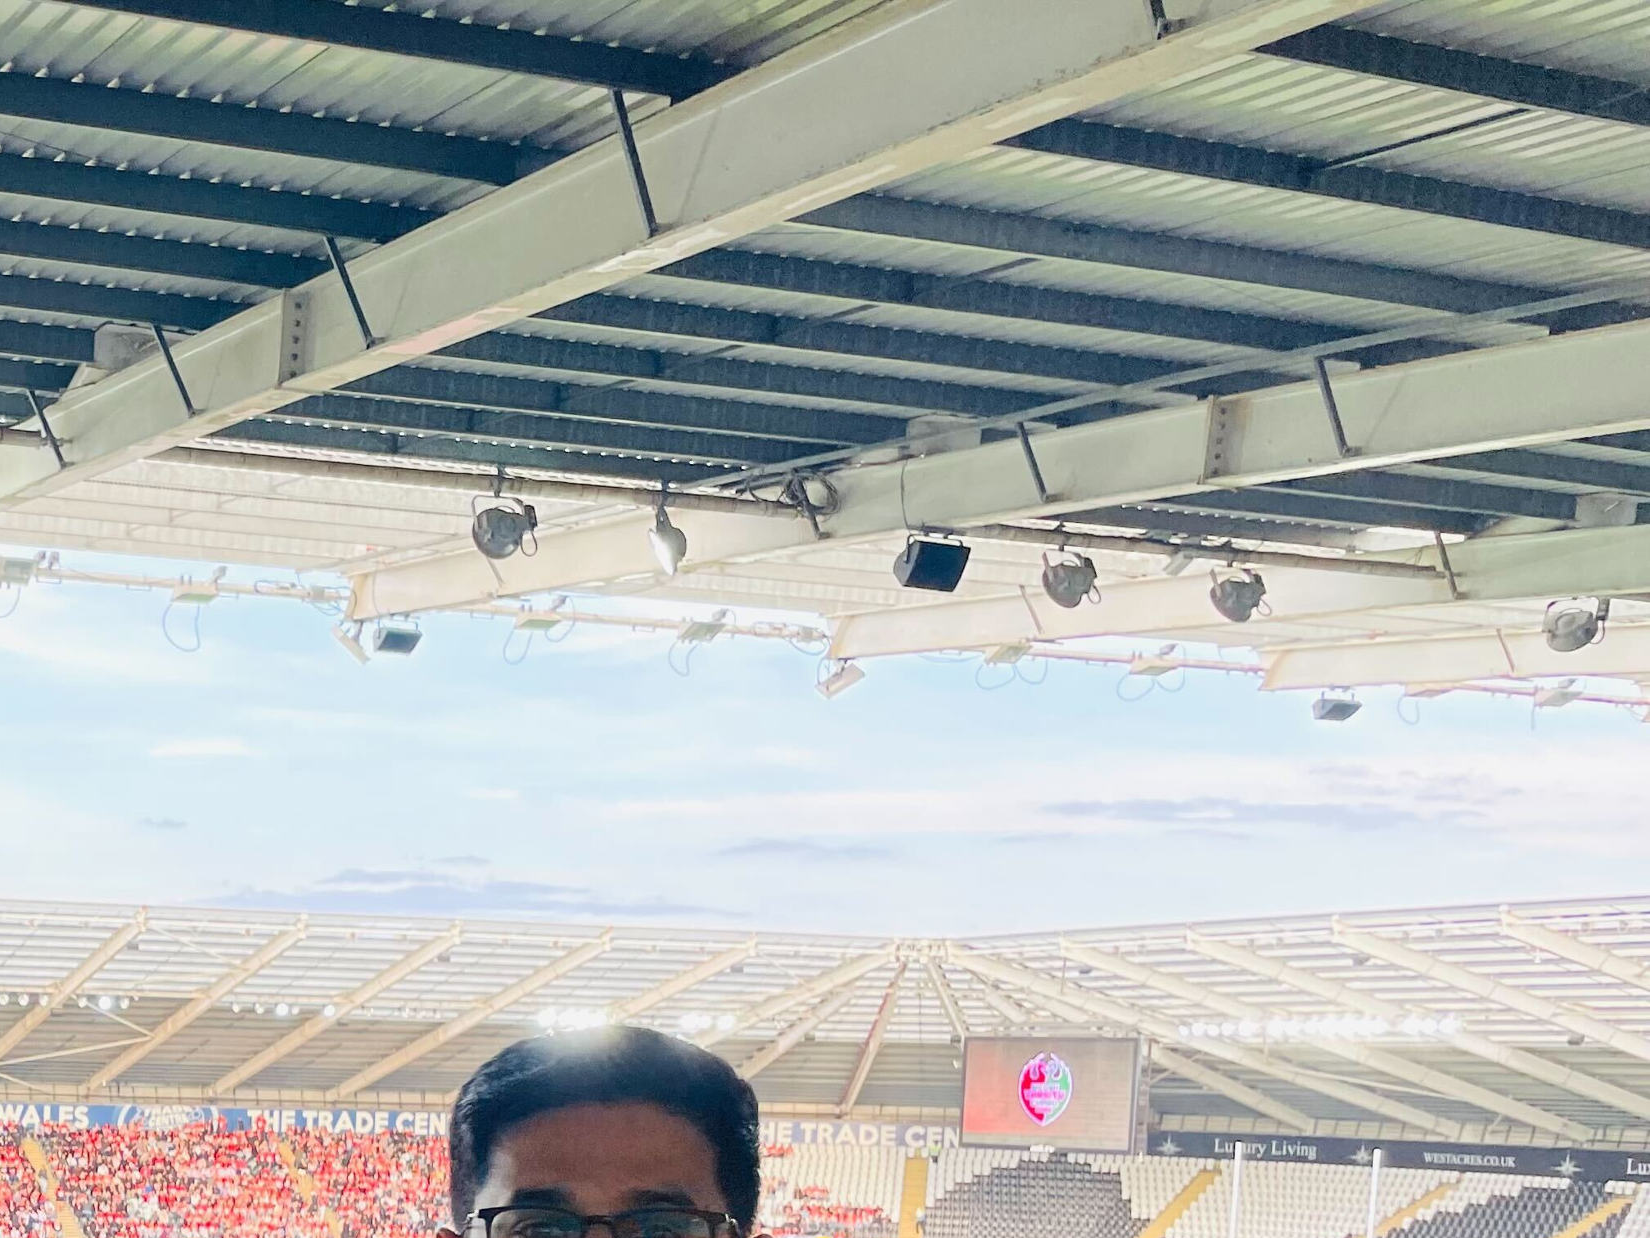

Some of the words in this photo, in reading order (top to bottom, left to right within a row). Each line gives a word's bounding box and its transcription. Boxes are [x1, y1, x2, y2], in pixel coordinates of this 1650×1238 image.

[247, 1109, 296, 1134] THE
[302, 1110, 389, 1135] TRADE
[800, 1122, 896, 1146] TRADE
[904, 1124, 960, 1148] CEN
[1213, 1138, 1267, 1157] Luury
[1271, 1141, 1318, 1160] Living
